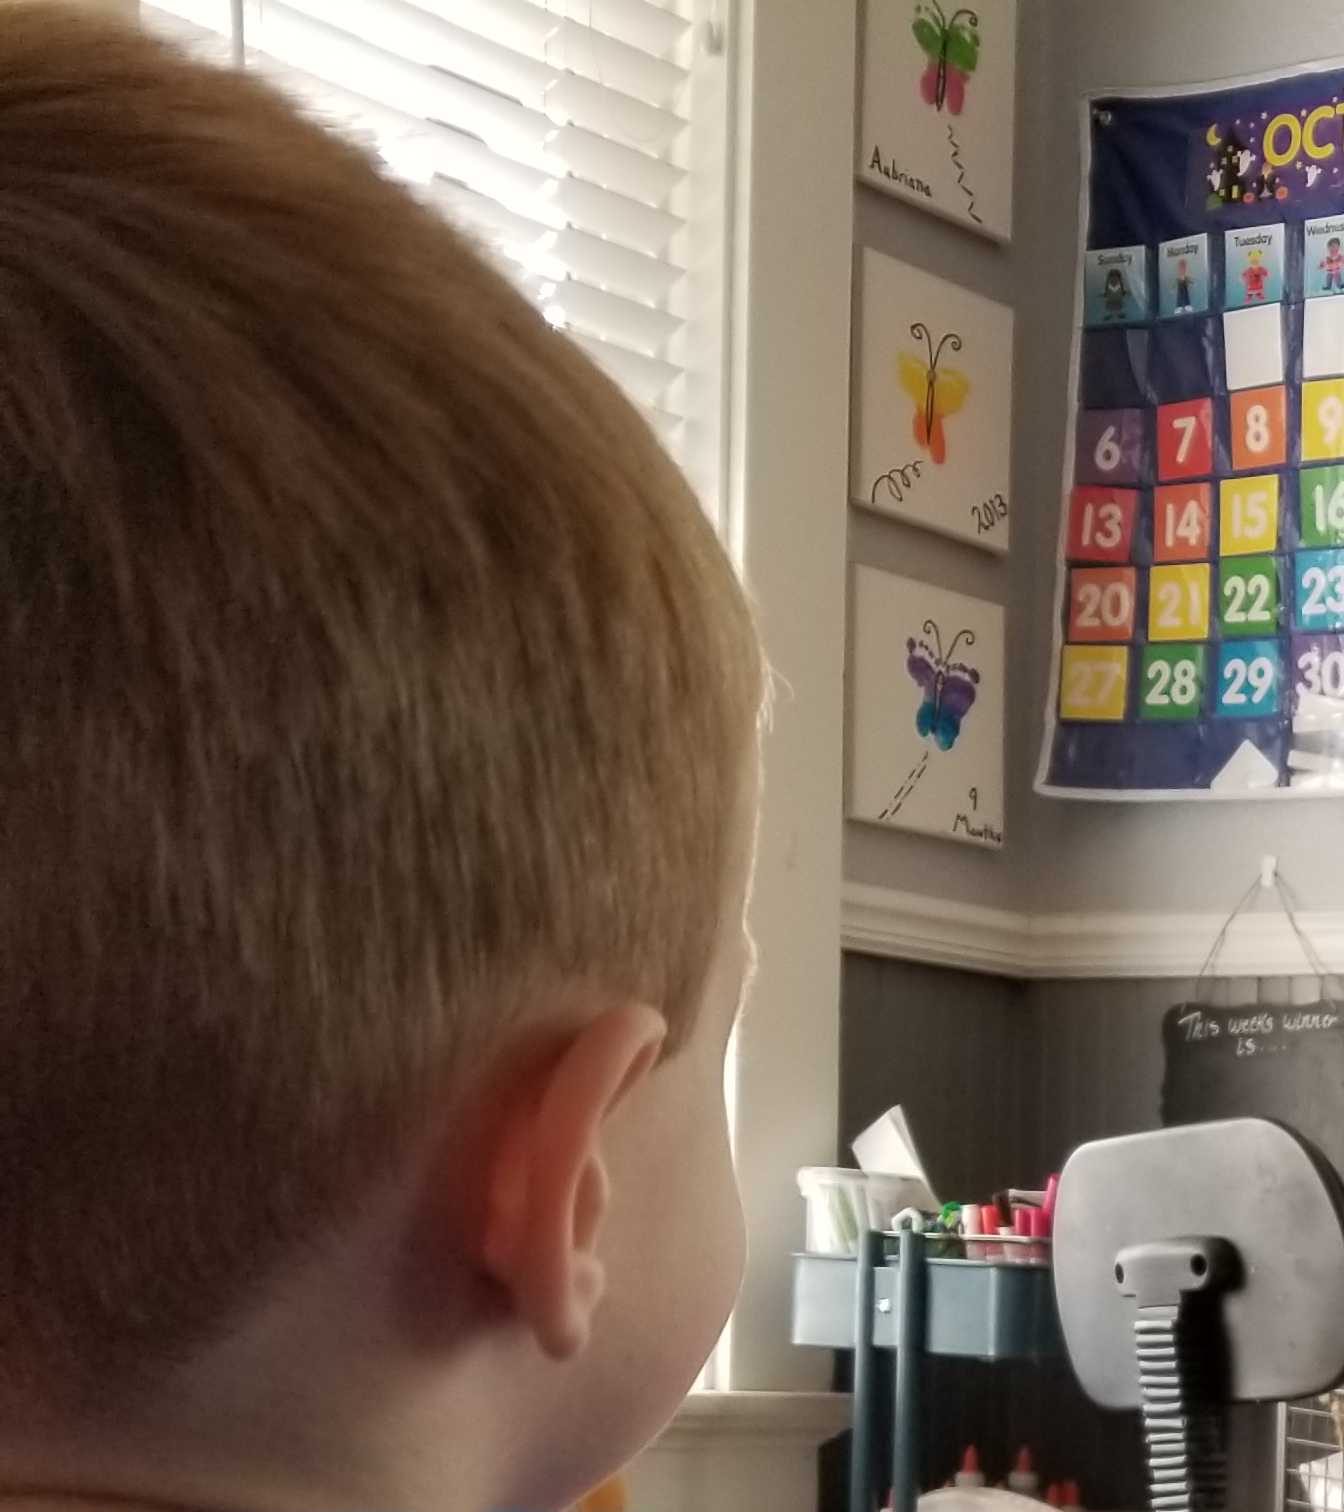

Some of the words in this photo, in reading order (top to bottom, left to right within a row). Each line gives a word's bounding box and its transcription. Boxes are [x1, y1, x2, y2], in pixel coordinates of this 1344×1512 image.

[1233, 231, 1272, 248] Tuesday
[1094, 425, 1121, 471] 6
[1173, 416, 1196, 463] 7
[1245, 404, 1268, 452] 8
[1317, 396, 1344, 445] 9
[1081, 502, 1121, 548] 13
[1165, 499, 1199, 547] 14
[1231, 488, 1268, 538] 15
[1076, 582, 1131, 626] 20
[1155, 579, 1199, 626] 21
[1223, 574, 1272, 622] 22
[1068, 661, 1121, 704] 27
[1146, 660, 1197, 704] 28
[1221, 657, 1273, 703] 29
[1178, 1010, 1220, 1041] This
[1283, 1012, 1338, 1030] winner
